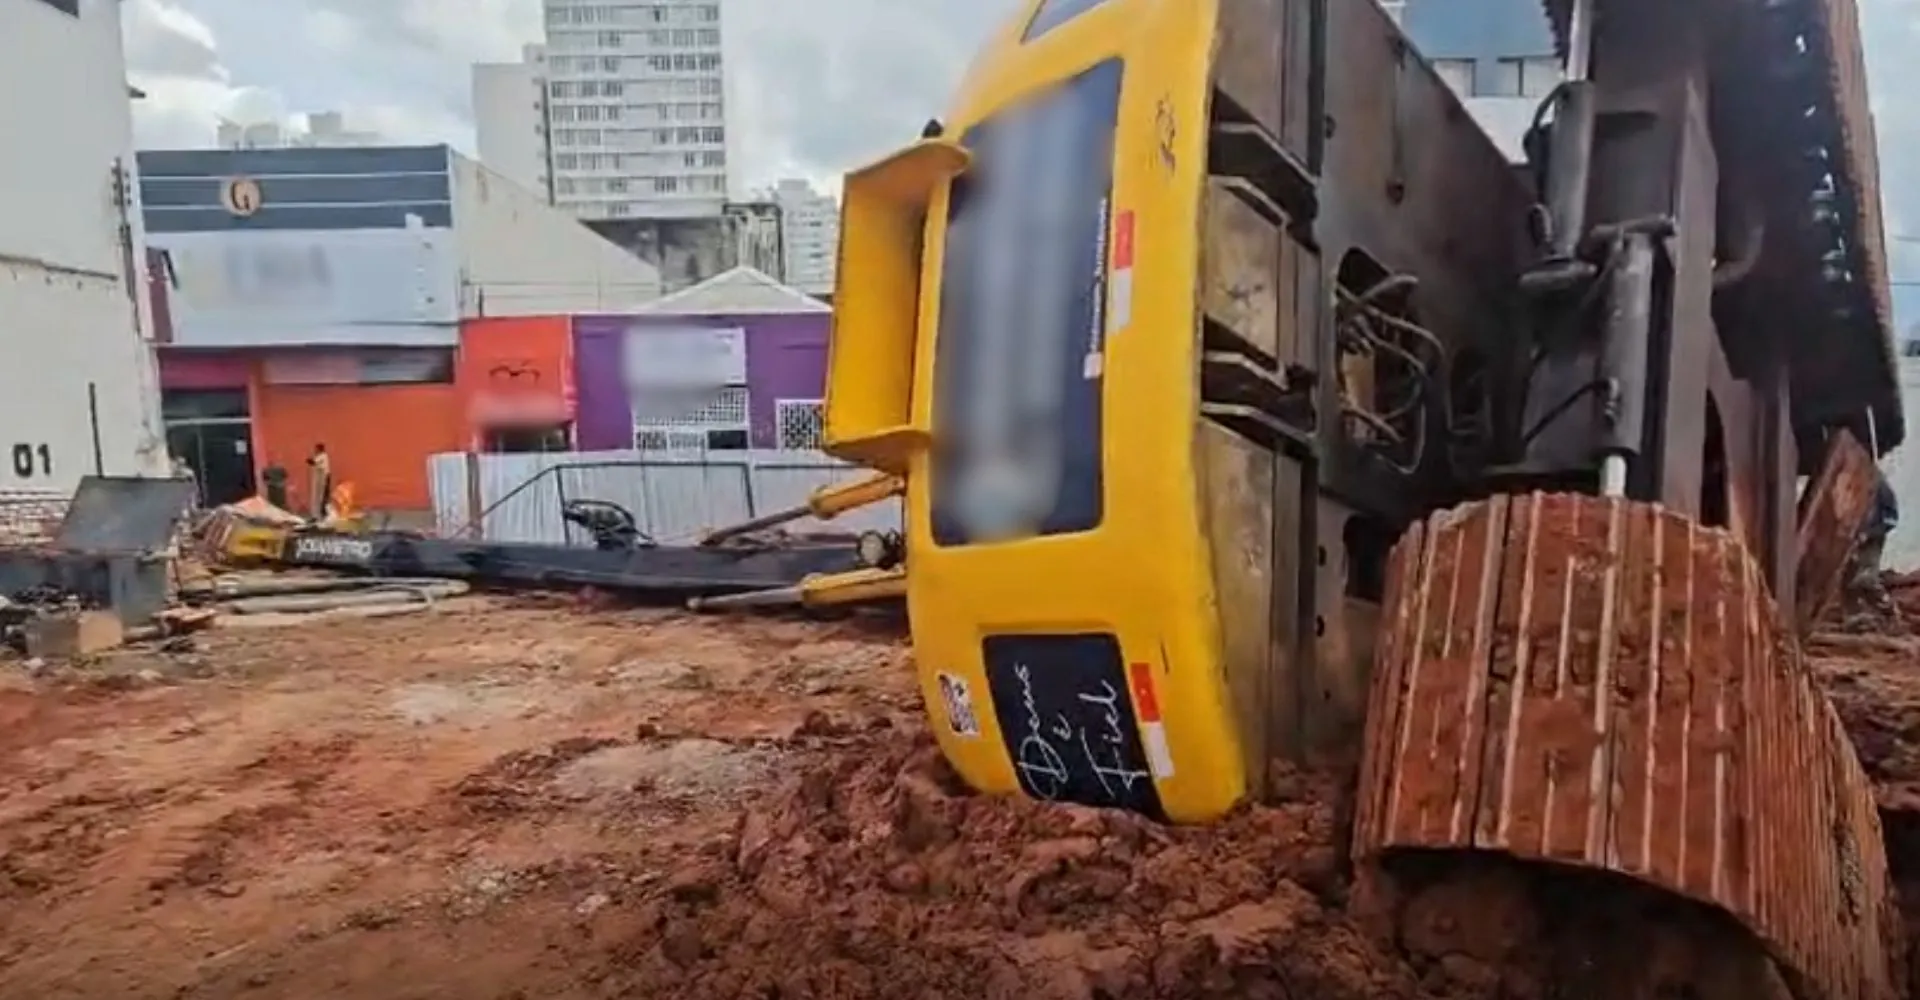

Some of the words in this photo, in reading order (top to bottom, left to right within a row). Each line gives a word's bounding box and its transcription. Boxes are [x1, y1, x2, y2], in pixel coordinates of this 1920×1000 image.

[13, 443, 51, 478] 01
[1014, 662, 1069, 801] Deus
[1077, 679, 1149, 799] Fiel
